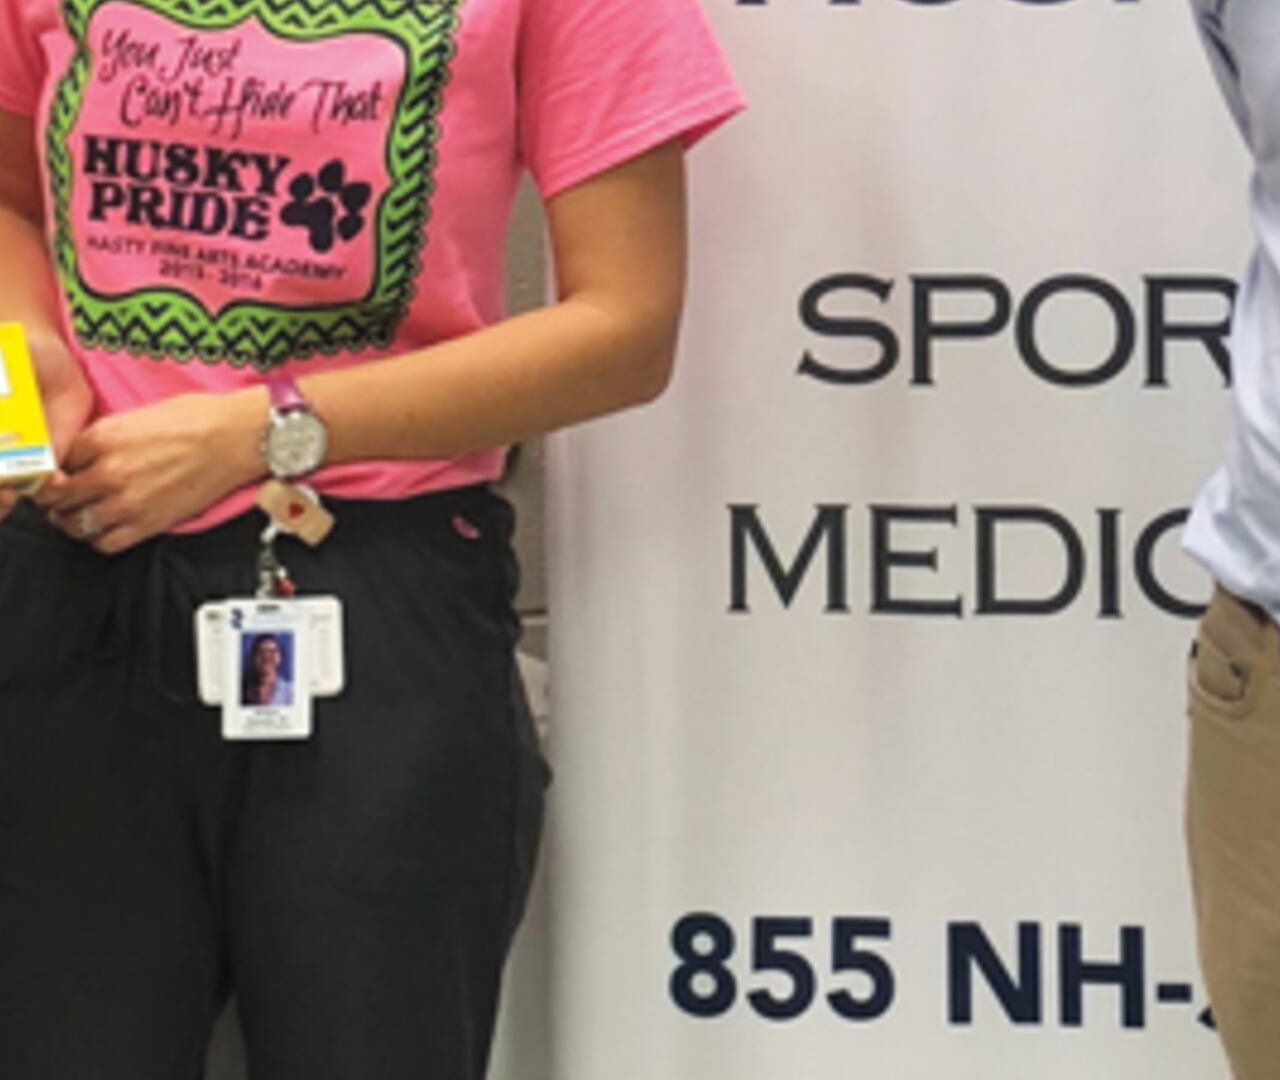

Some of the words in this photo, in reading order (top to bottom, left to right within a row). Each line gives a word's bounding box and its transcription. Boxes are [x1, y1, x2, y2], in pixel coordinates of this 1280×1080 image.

[98, 27, 160, 83] You
[157, 34, 241, 83] Just
[121, 73, 203, 127] Can't
[201, 76, 299, 140] Hide
[300, 78, 383, 134] That
[83, 134, 291, 197] HUSKY
[88, 181, 270, 242] PRIDE
[86, 234, 146, 256] HASTY
[196, 244, 241, 269] ARTS
[246, 253, 348, 281] ACADEMY
[795, 272, 1240, 389] SPOR
[726, 502, 1214, 620] MEDIC
[669, 911, 895, 1021] 855
[946, 920, 1218, 1029] NH-
